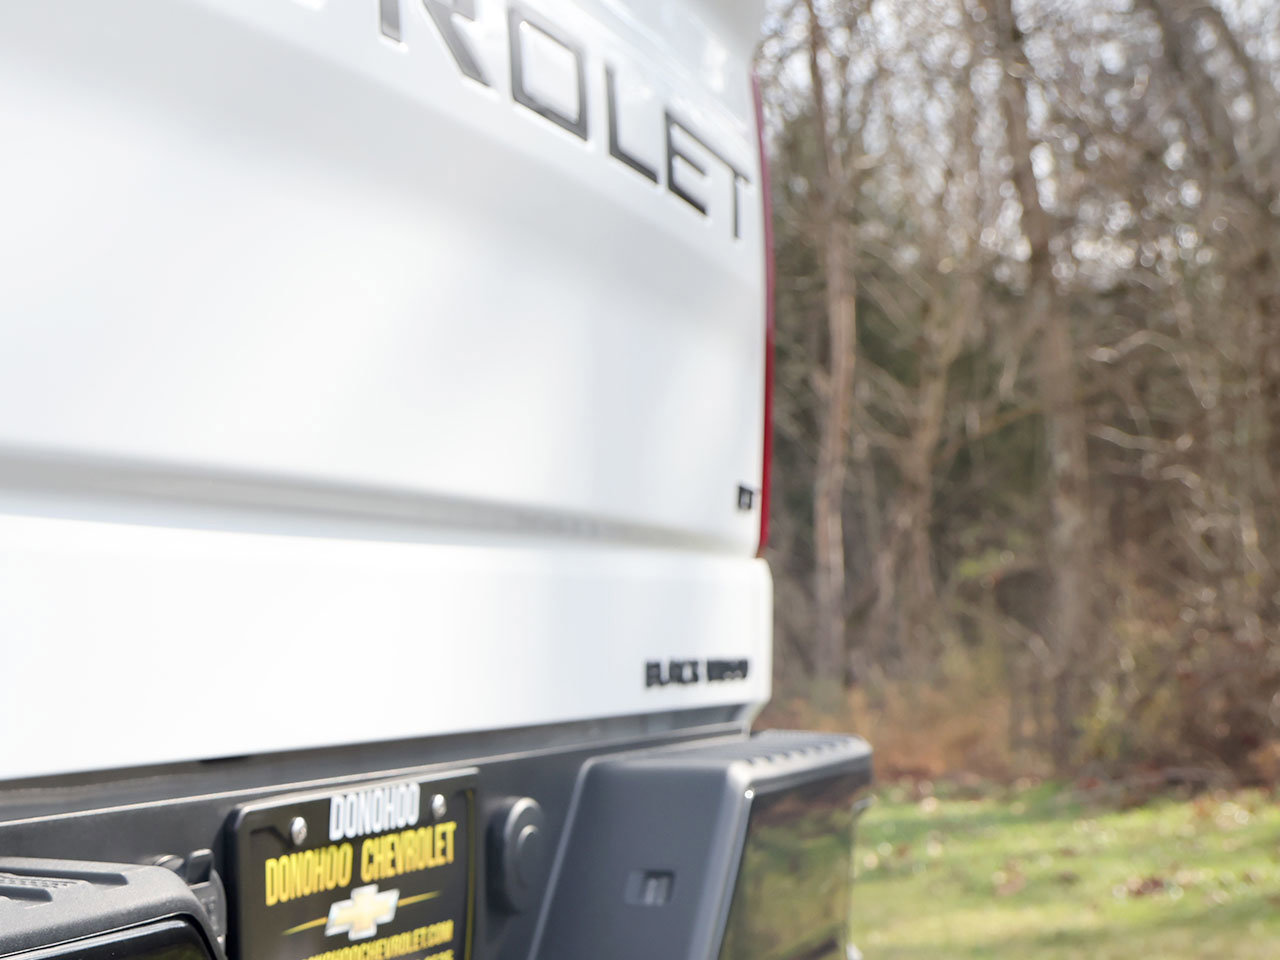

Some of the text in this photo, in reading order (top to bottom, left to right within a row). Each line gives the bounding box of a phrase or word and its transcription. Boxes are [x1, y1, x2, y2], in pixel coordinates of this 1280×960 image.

[329, 782, 421, 841] DONOHOO
[265, 821, 457, 907] DONOHOO CHEVROLET
